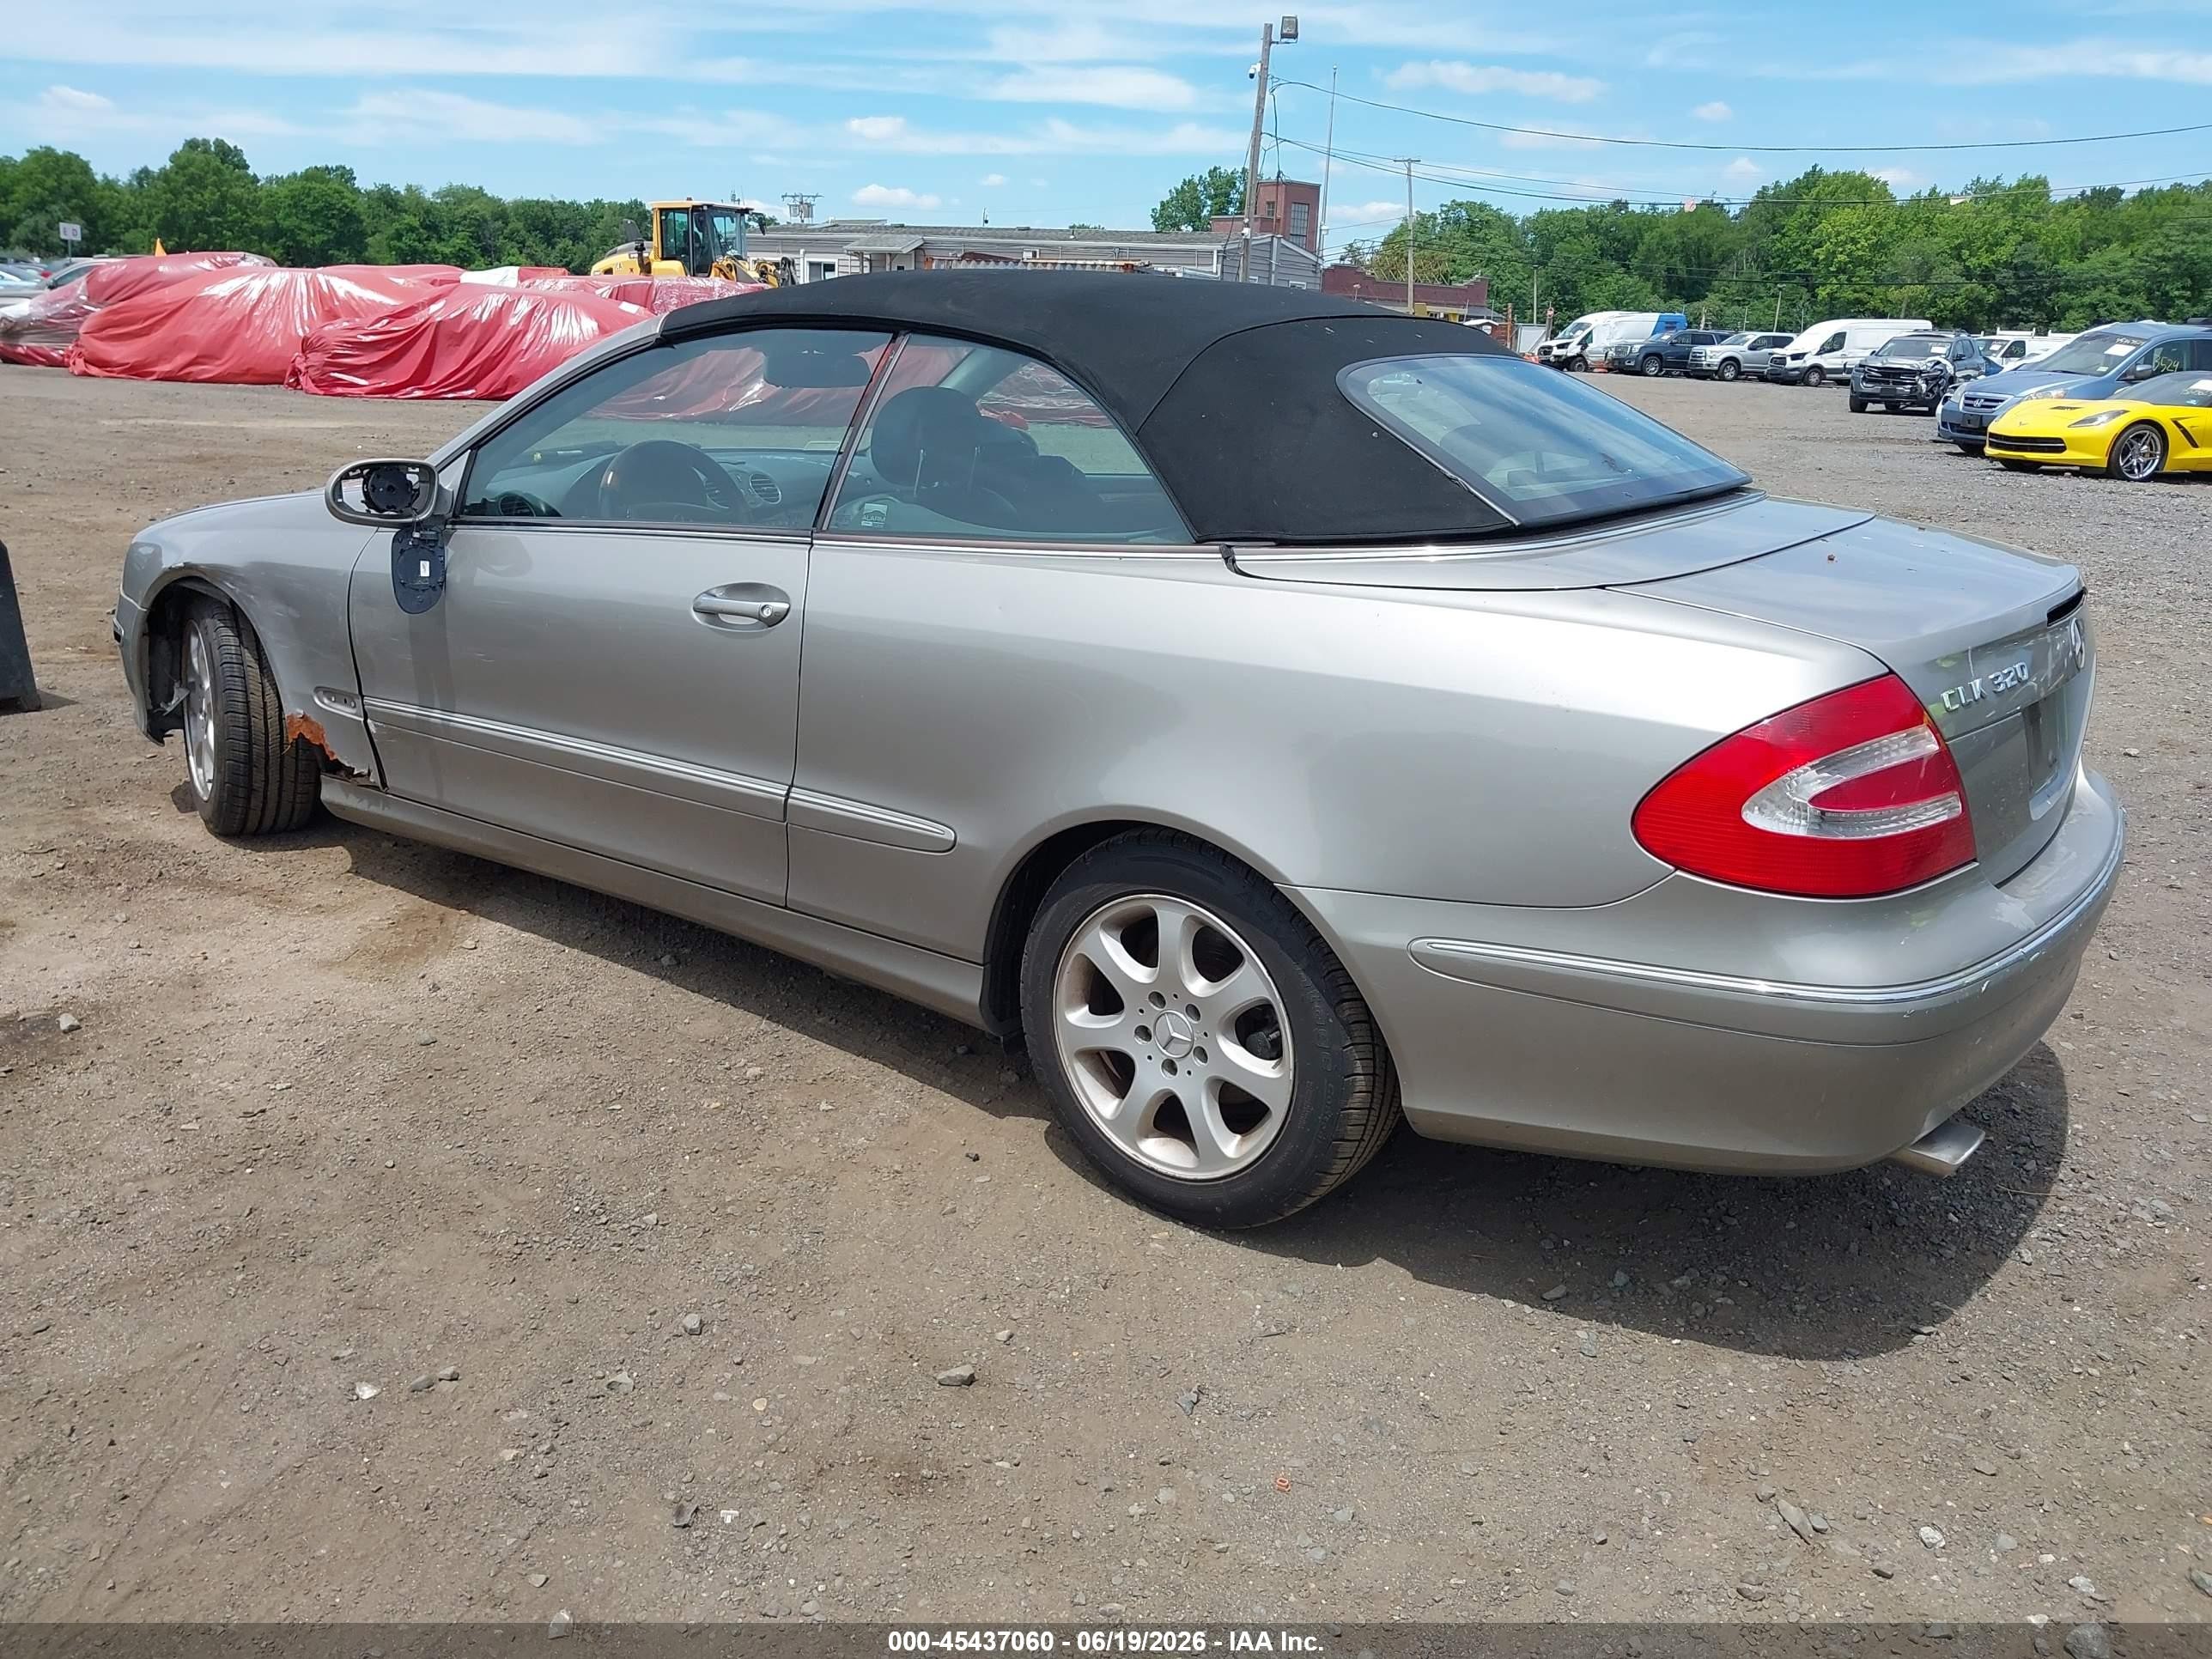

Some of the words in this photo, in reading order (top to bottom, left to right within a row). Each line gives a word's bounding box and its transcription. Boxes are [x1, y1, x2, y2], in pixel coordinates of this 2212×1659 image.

[861, 514, 886, 523] ALARM
[1940, 678, 1988, 713] CLK
[1988, 661, 2029, 693] 320
